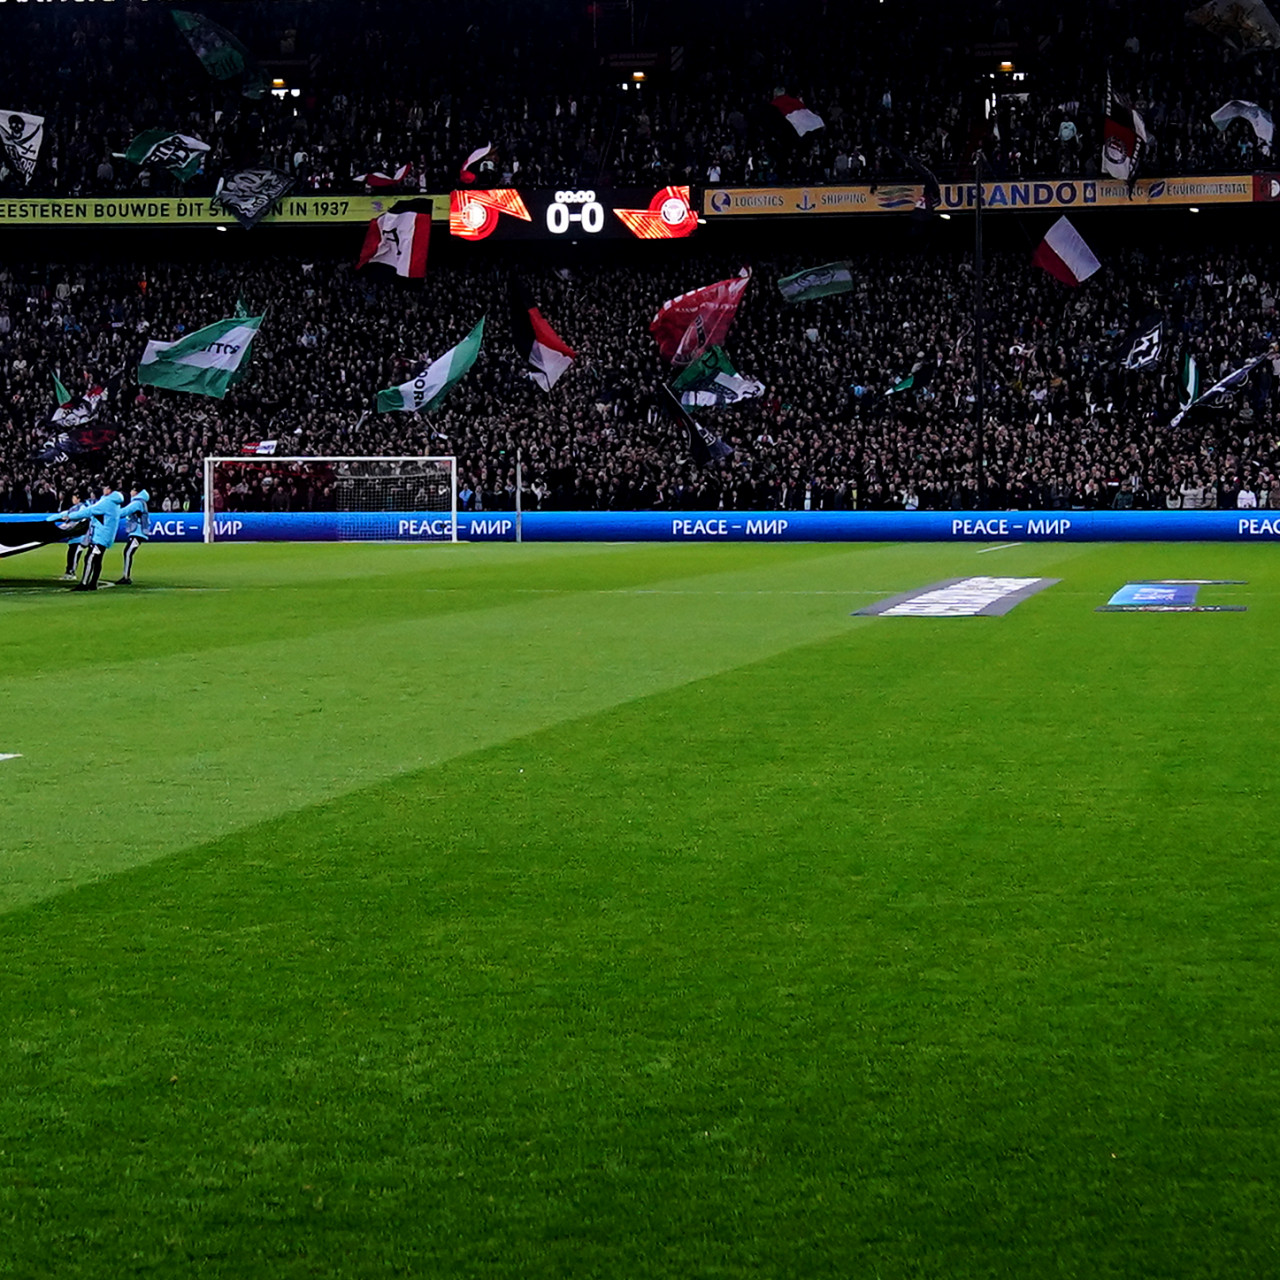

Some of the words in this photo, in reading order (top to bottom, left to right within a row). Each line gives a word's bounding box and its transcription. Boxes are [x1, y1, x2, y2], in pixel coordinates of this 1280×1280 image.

[555, 190, 596, 203] 00:00
[944, 183, 1076, 208] URANDO
[1166, 183, 1247, 196] ENVIRONMENTAL
[735, 196, 784, 207] LOGISTICS
[821, 194, 867, 205] SHIPPING
[95, 202, 170, 218] BOUWDE
[178, 202, 203, 217] DIT
[290, 202, 307, 216] IN
[314, 201, 349, 216] 1937
[546, 202, 604, 233] 0-0
[399, 520, 452, 535] PEACE
[470, 520, 511, 535] МИР
[672, 520, 727, 535] PEACE
[745, 520, 788, 535] МИР
[952, 519, 1008, 535] PEACE
[1026, 519, 1071, 535] МИР
